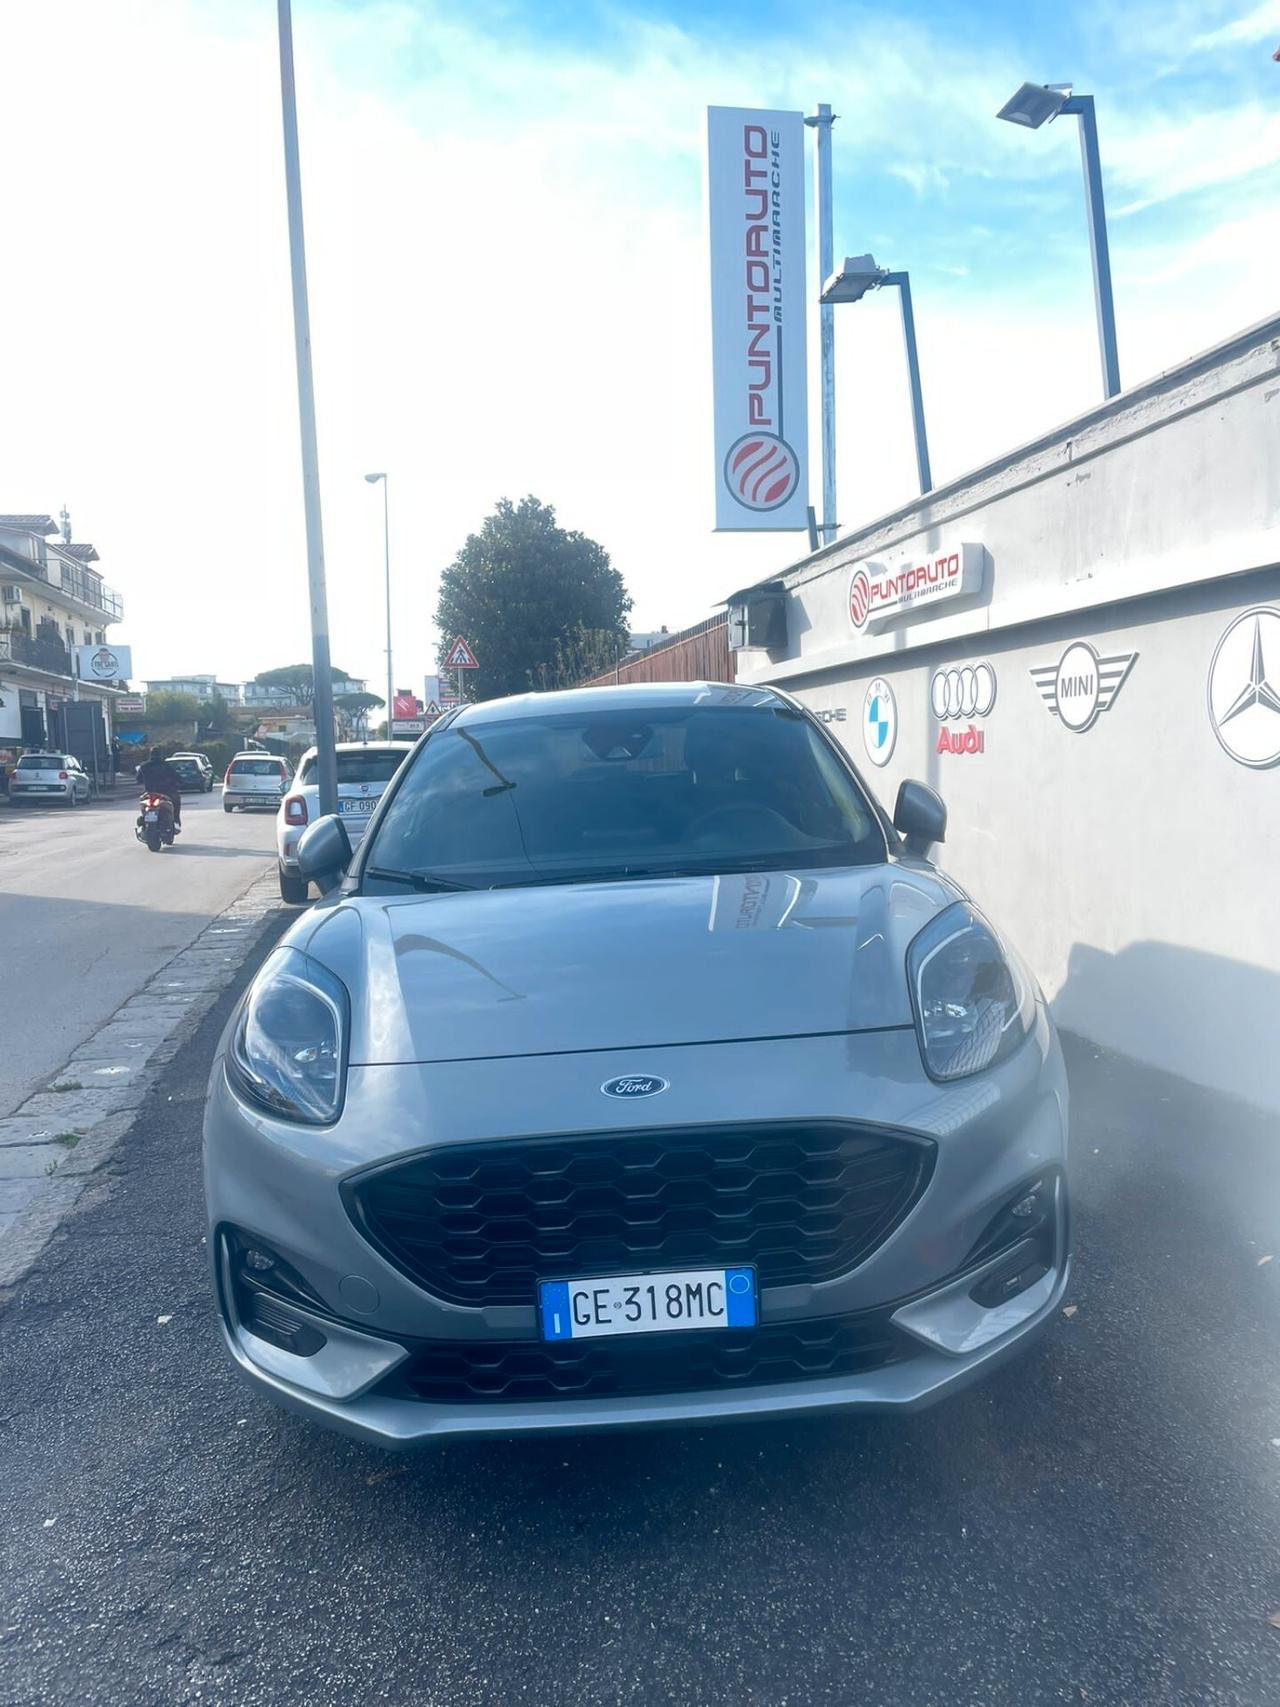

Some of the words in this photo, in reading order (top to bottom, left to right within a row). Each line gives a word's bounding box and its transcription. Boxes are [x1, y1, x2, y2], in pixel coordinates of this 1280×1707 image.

[771, 130, 784, 322] MULTIMARCHE
[744, 125, 772, 426] PUNTOAUTO
[870, 554, 959, 604] PUNTOAUTO
[1060, 674, 1094, 699] MINI
[615, 1079, 652, 1093] Ford
[572, 1289, 612, 1326] GE
[623, 1281, 725, 1322] 318MC
